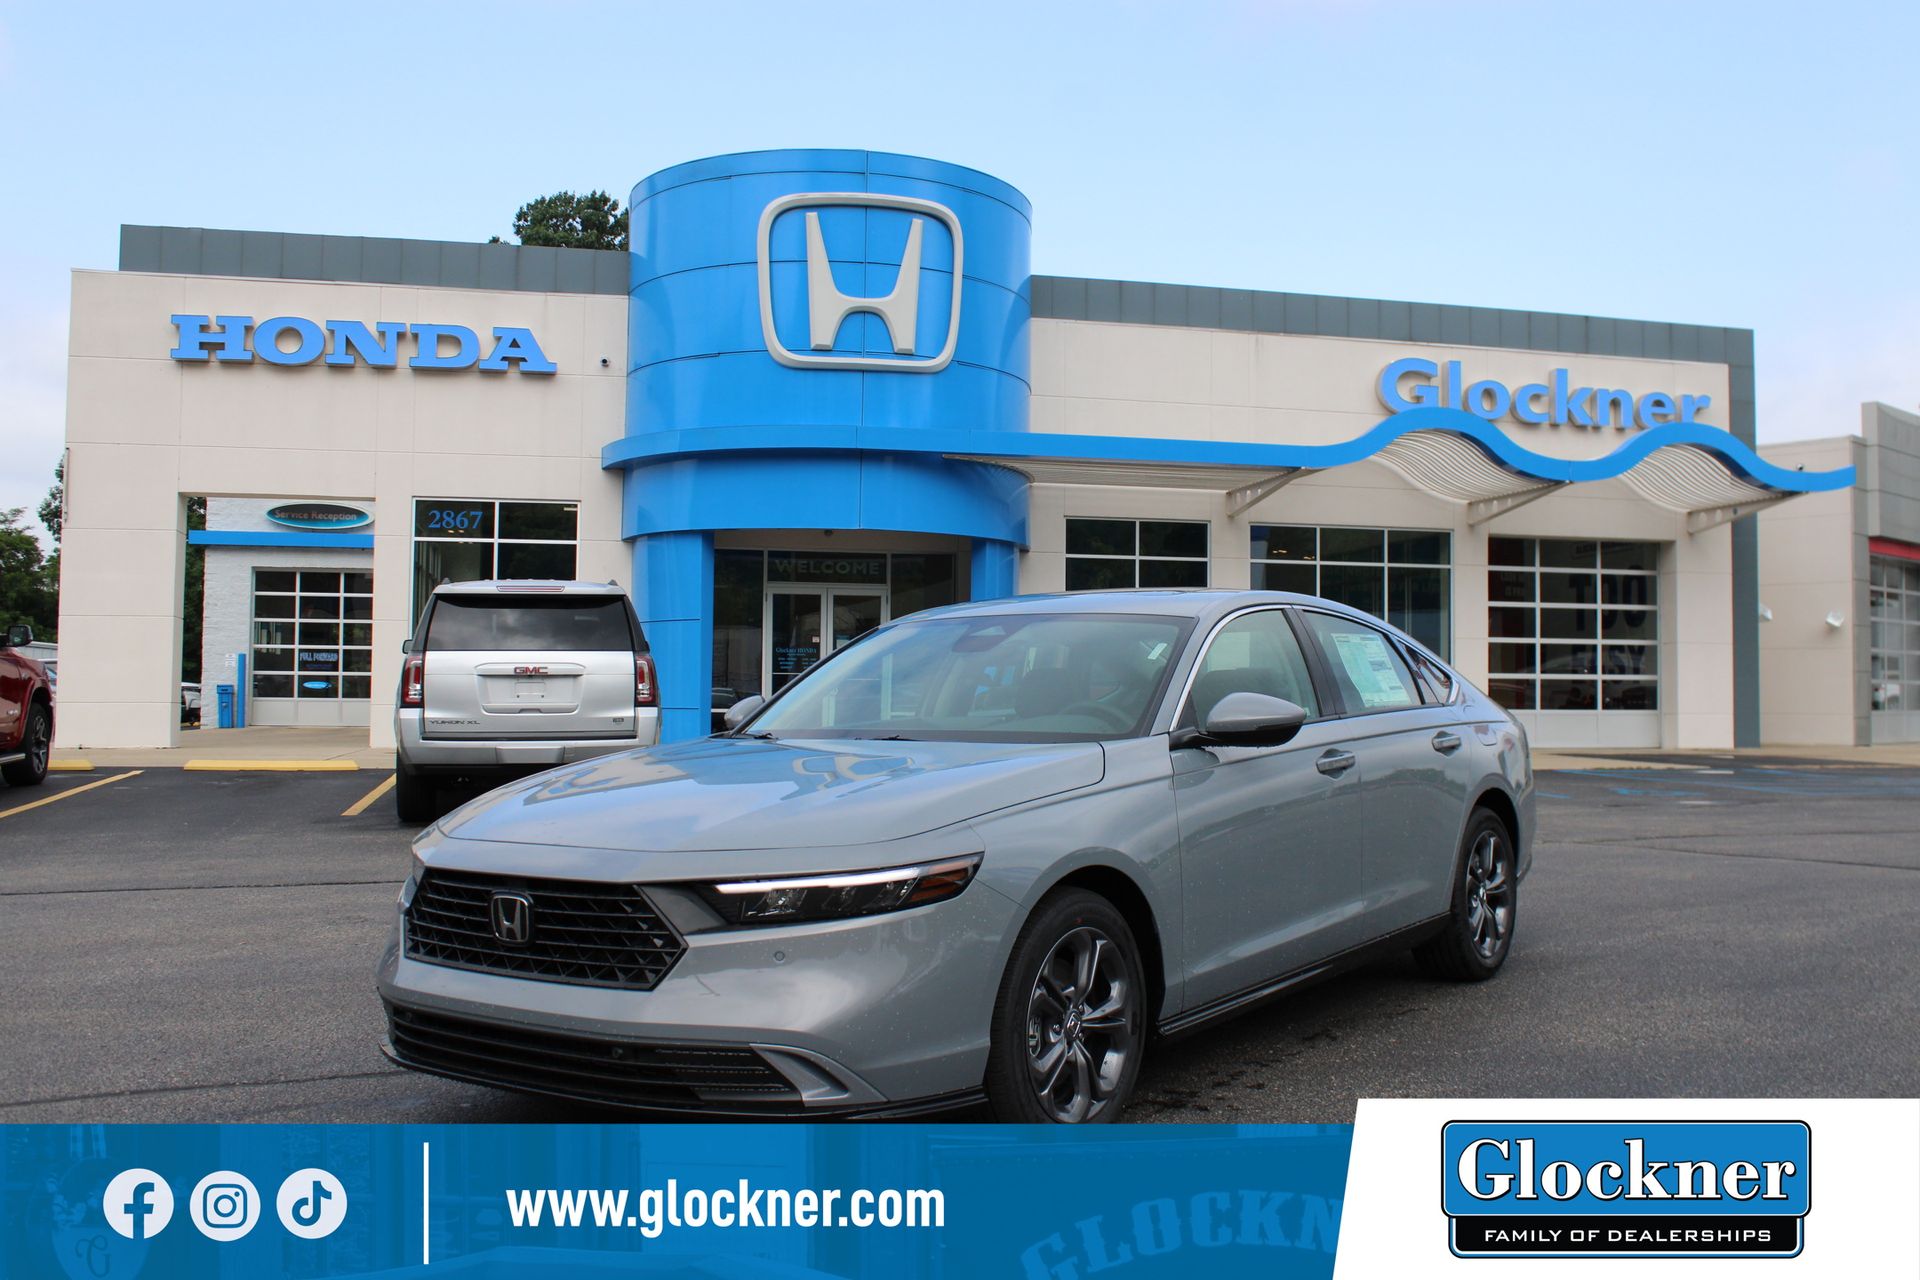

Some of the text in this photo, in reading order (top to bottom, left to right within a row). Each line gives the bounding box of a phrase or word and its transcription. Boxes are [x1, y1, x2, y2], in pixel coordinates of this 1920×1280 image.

[170, 313, 557, 374] HONDA
[1376, 357, 1712, 429] Glockner
[274, 510, 357, 522] Service Reception
[428, 510, 483, 529] 2867
[775, 559, 880, 575] WELCOME
[513, 666, 549, 675] GMC
